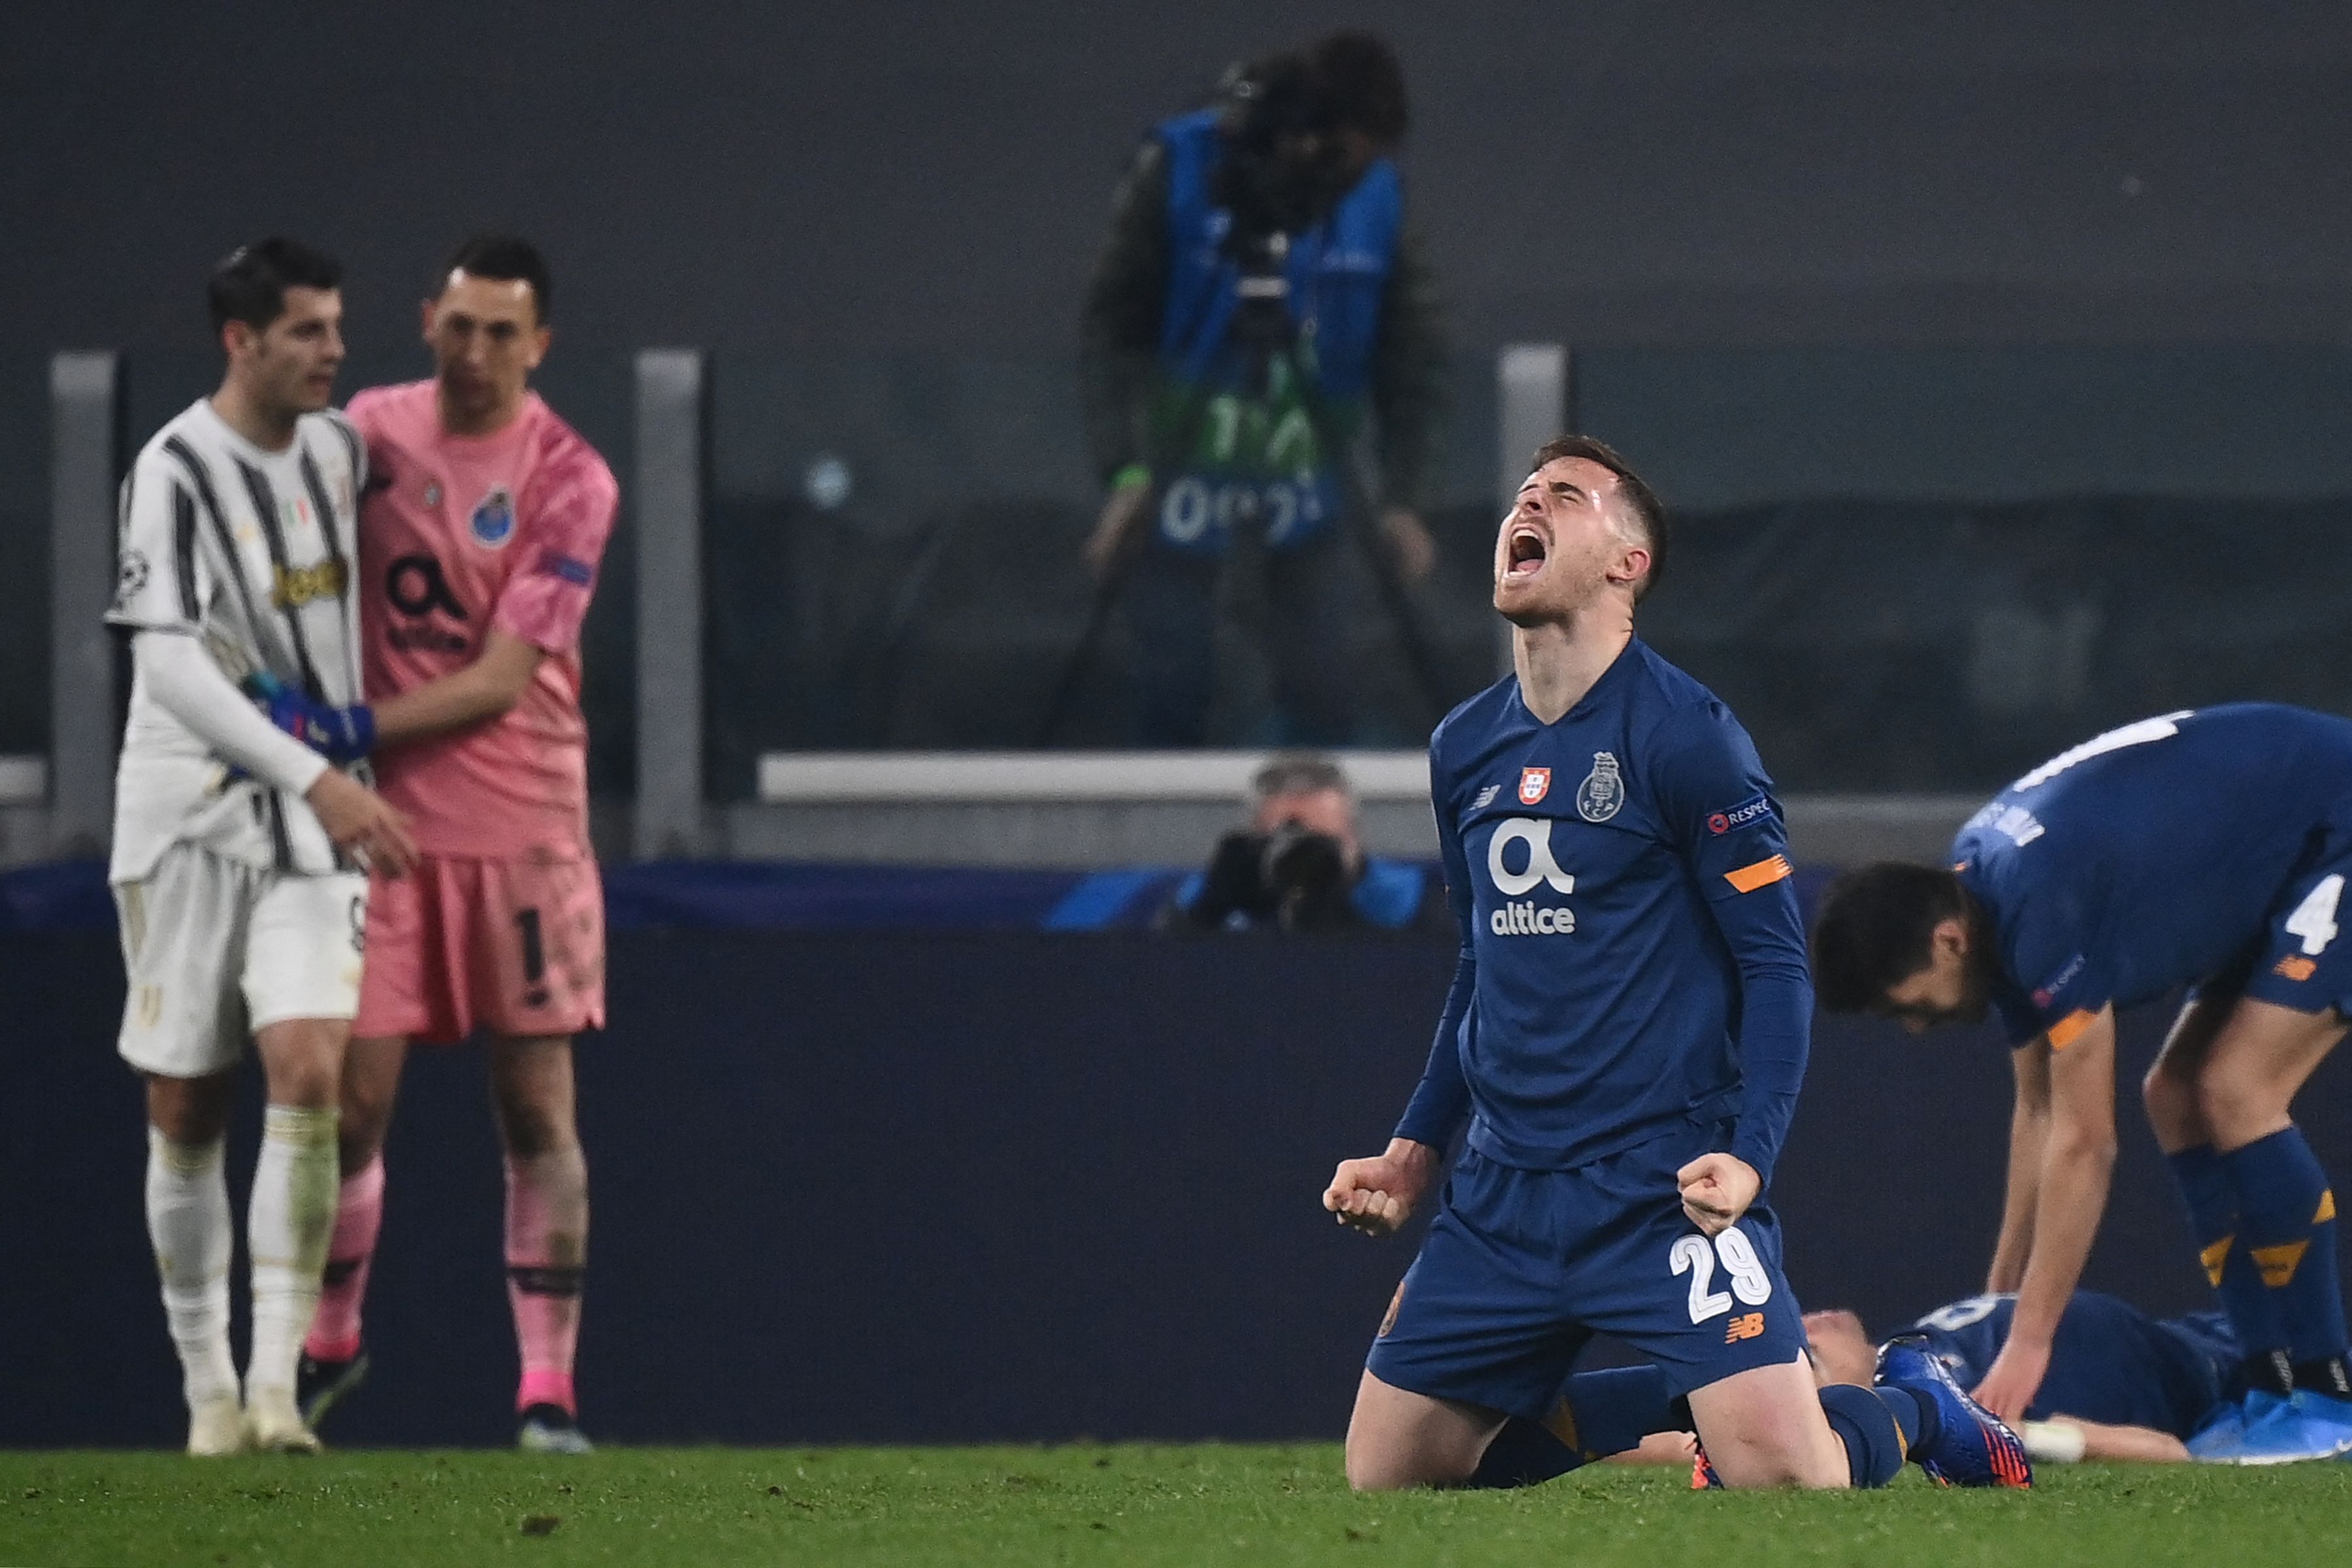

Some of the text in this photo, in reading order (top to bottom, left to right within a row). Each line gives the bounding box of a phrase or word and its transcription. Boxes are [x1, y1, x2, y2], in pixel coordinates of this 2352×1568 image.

[515, 907, 544, 982] 1
[1491, 900, 1575, 935] altice
[2285, 874, 2345, 955] 4
[1669, 1227, 1772, 1324] 29
